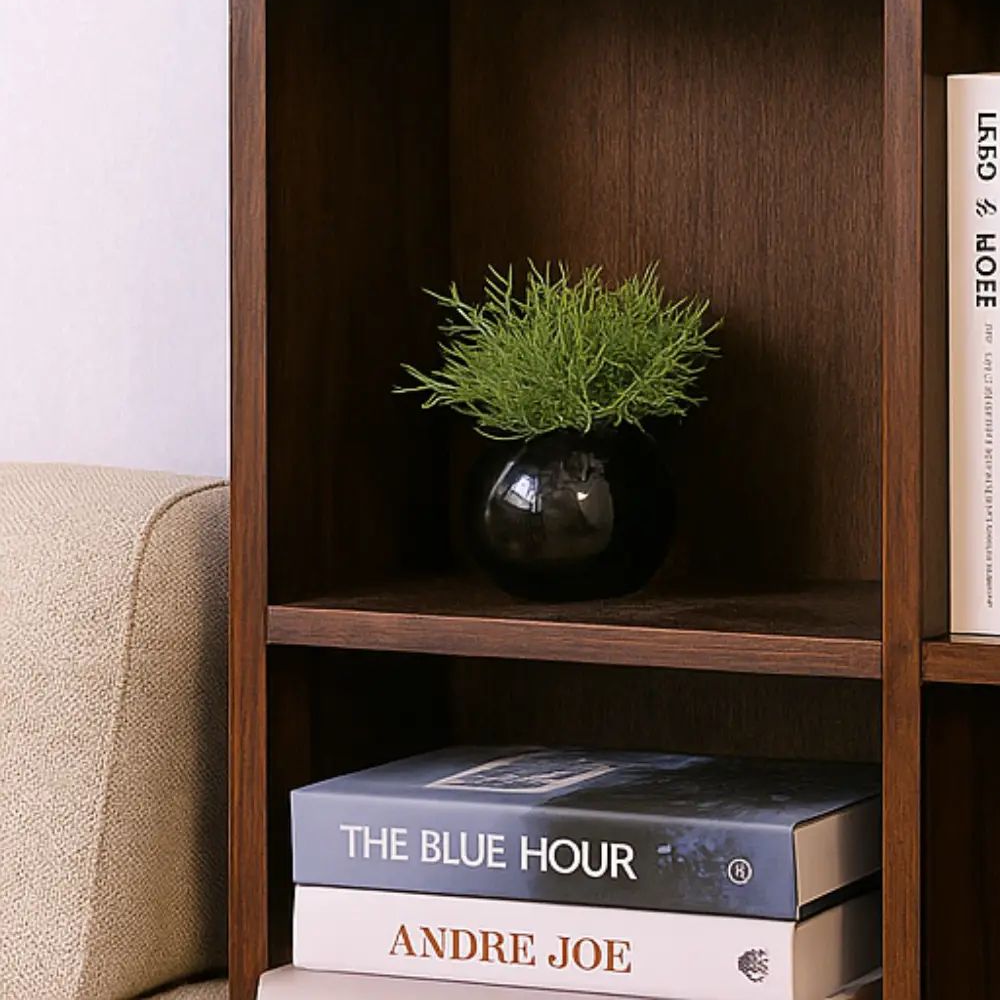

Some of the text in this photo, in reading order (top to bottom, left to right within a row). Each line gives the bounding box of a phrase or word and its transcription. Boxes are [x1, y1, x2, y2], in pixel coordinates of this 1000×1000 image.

[340, 824, 637, 880] THE BLUE HOUR
[389, 924, 632, 973] ANDRE JOE
